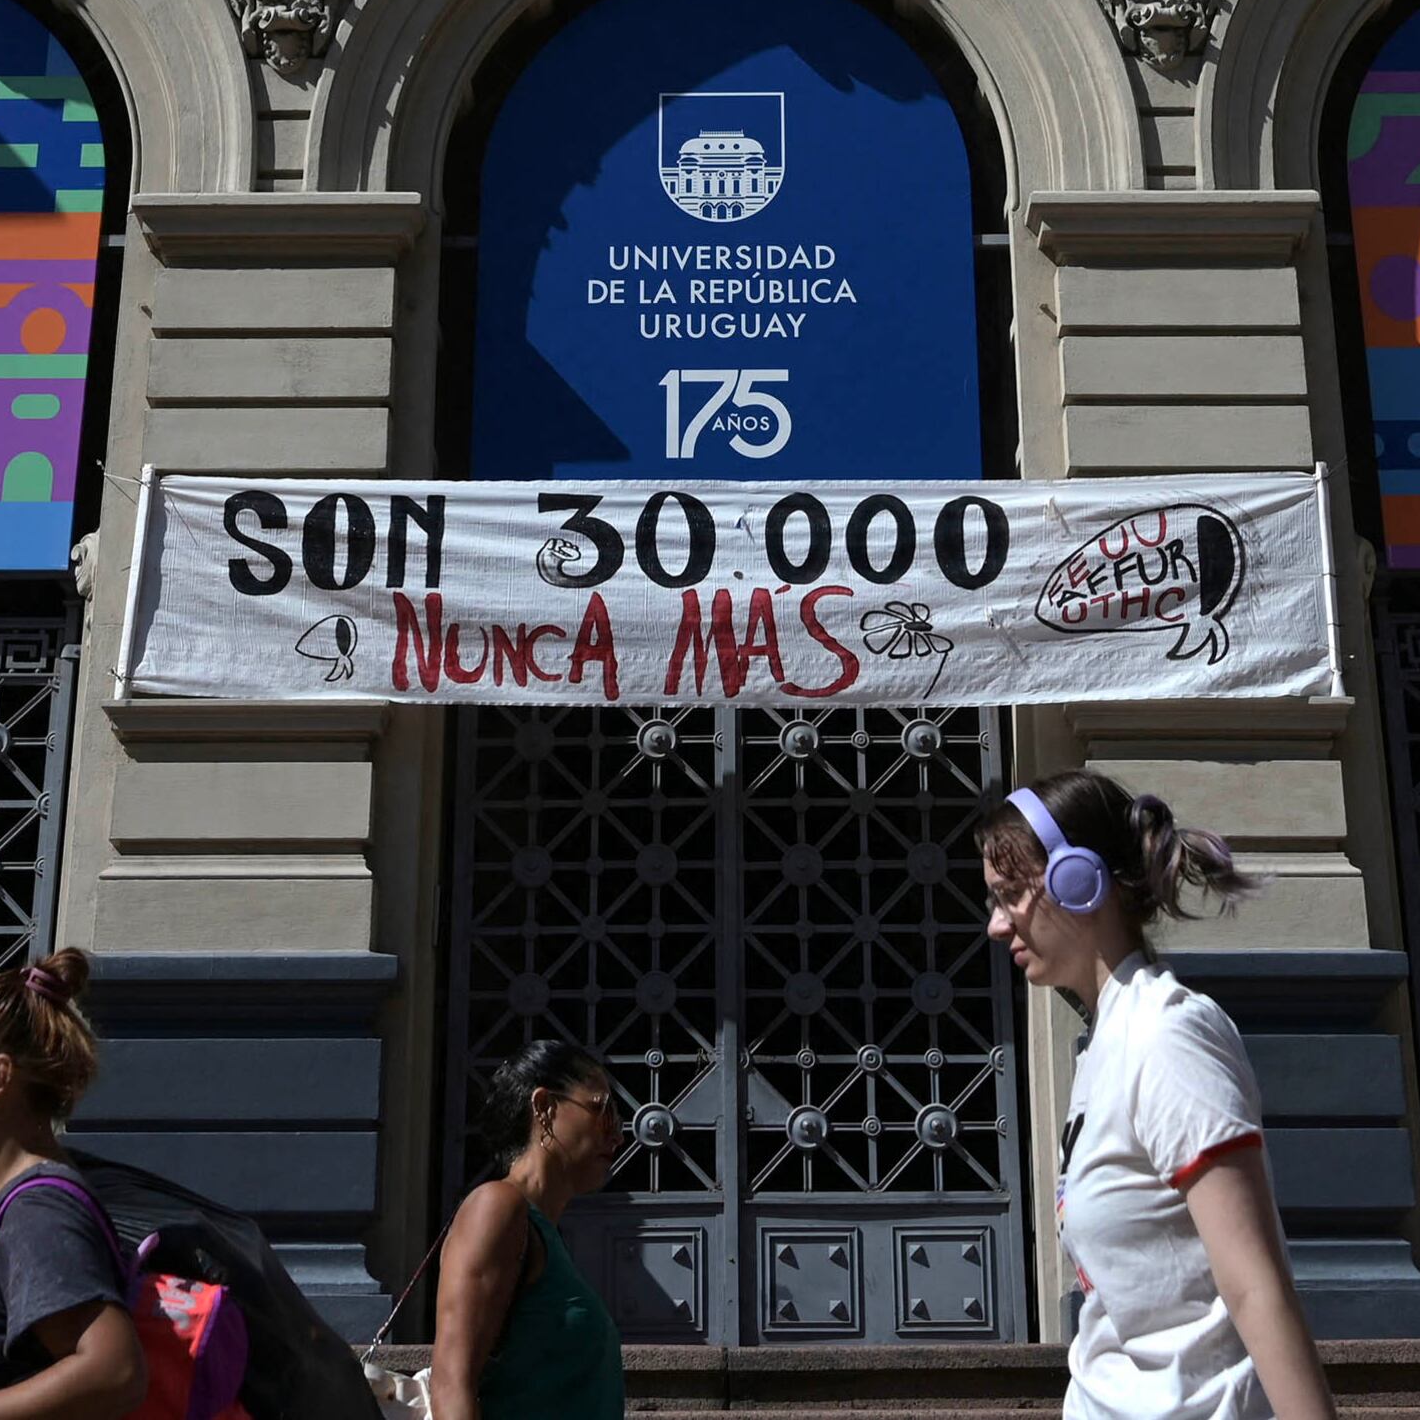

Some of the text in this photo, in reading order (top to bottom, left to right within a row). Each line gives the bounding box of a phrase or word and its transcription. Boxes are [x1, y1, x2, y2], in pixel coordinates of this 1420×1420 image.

[608, 244, 836, 271] UNIVERSIDAD
[587, 272, 857, 304] DE LA REPÚBLICA
[639, 312, 807, 339] URUGUAY
[658, 368, 793, 459] 175
[712, 413, 770, 432] AÑOS
[223, 489, 1010, 596] SON 30.000
[1056, 538, 1198, 609] AFFUR
[1061, 586, 1186, 624] UTHC
[392, 584, 860, 701] NUNCA MÁS
